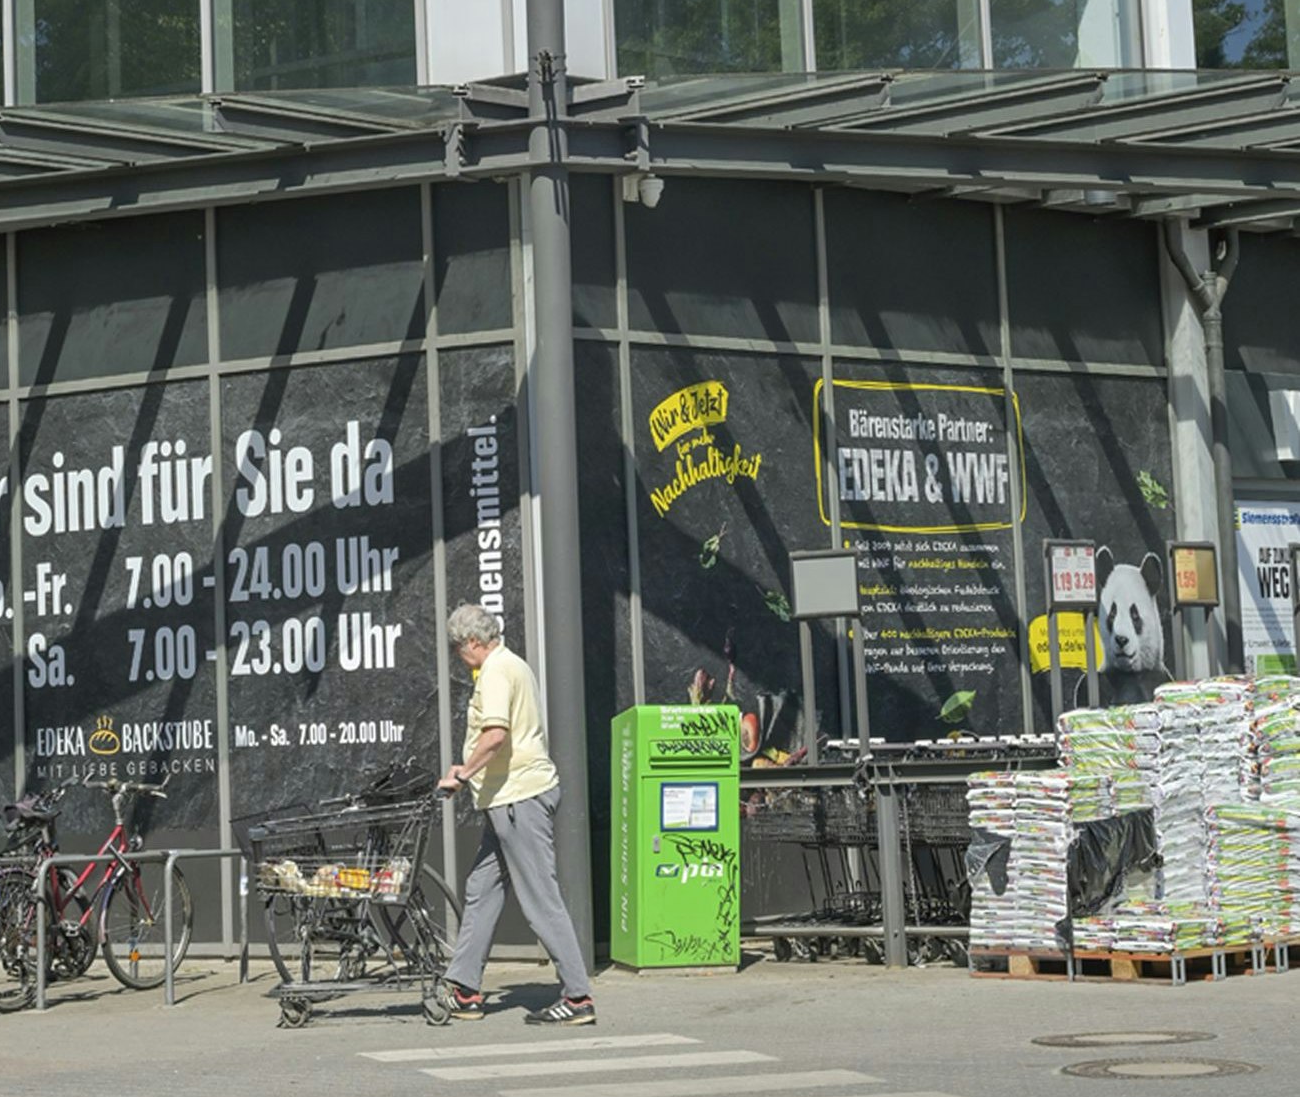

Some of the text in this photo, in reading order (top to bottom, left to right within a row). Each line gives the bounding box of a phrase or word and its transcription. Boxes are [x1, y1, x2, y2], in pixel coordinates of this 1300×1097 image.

[651, 388, 724, 442] Wir & Jetzt
[849, 409, 994, 443] Bärenstarke Partner:
[24, 445, 125, 536] sind
[138, 439, 213, 525] für
[236, 428, 314, 517] Sie
[331, 420, 394, 509] da
[650, 444, 762, 517] Nachhaltigkeit
[838, 448, 1009, 504] EDEKA & WWF
[467, 414, 505, 640] bensmittel.
[125, 552, 192, 609] 7.00
[229, 541, 326, 602] 24.00
[336, 536, 399, 595] Uhr
[1257, 566, 1290, 599] WEG
[27, 632, 74, 689] Sa.
[127, 624, 197, 682] 7.00
[229, 616, 326, 676] 23.00
[338, 611, 402, 671] Uhr
[37, 719, 214, 757] EDEKA BACKSTUBE
[235, 725, 259, 748] Mo.
[270, 728, 290, 747] Sa.
[299, 723, 327, 746] 7.00
[339, 722, 377, 744] 20.00
[380, 720, 404, 743] Uhr
[37, 758, 216, 778] MIT LIEBE GEBACKEN
[681, 857, 724, 883] pin
